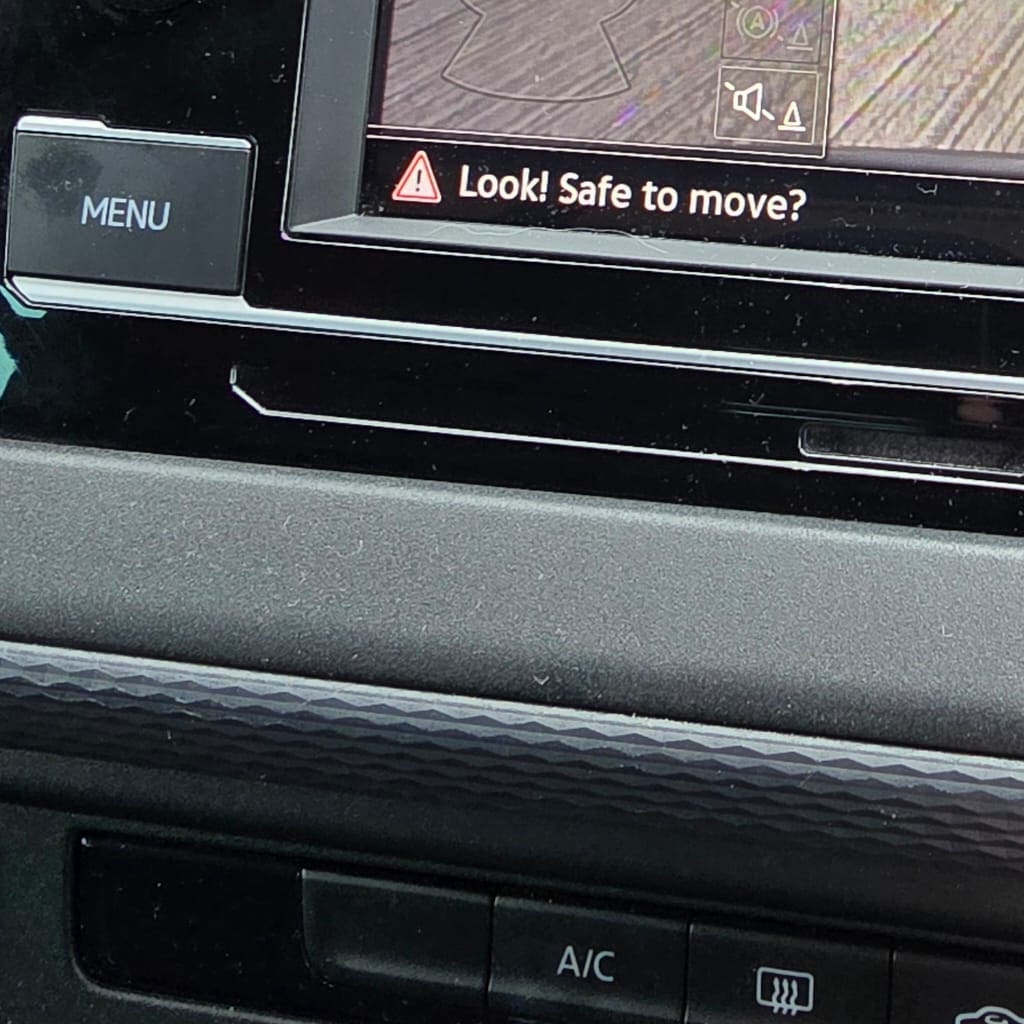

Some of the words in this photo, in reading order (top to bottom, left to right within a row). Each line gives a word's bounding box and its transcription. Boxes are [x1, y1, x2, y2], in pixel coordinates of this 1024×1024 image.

[459, 164, 549, 203] Look!
[558, 172, 632, 209] Safe
[641, 181, 678, 212] to
[689, 187, 807, 222] move?
[81, 195, 171, 231] MENU
[556, 945, 615, 982] A/C
